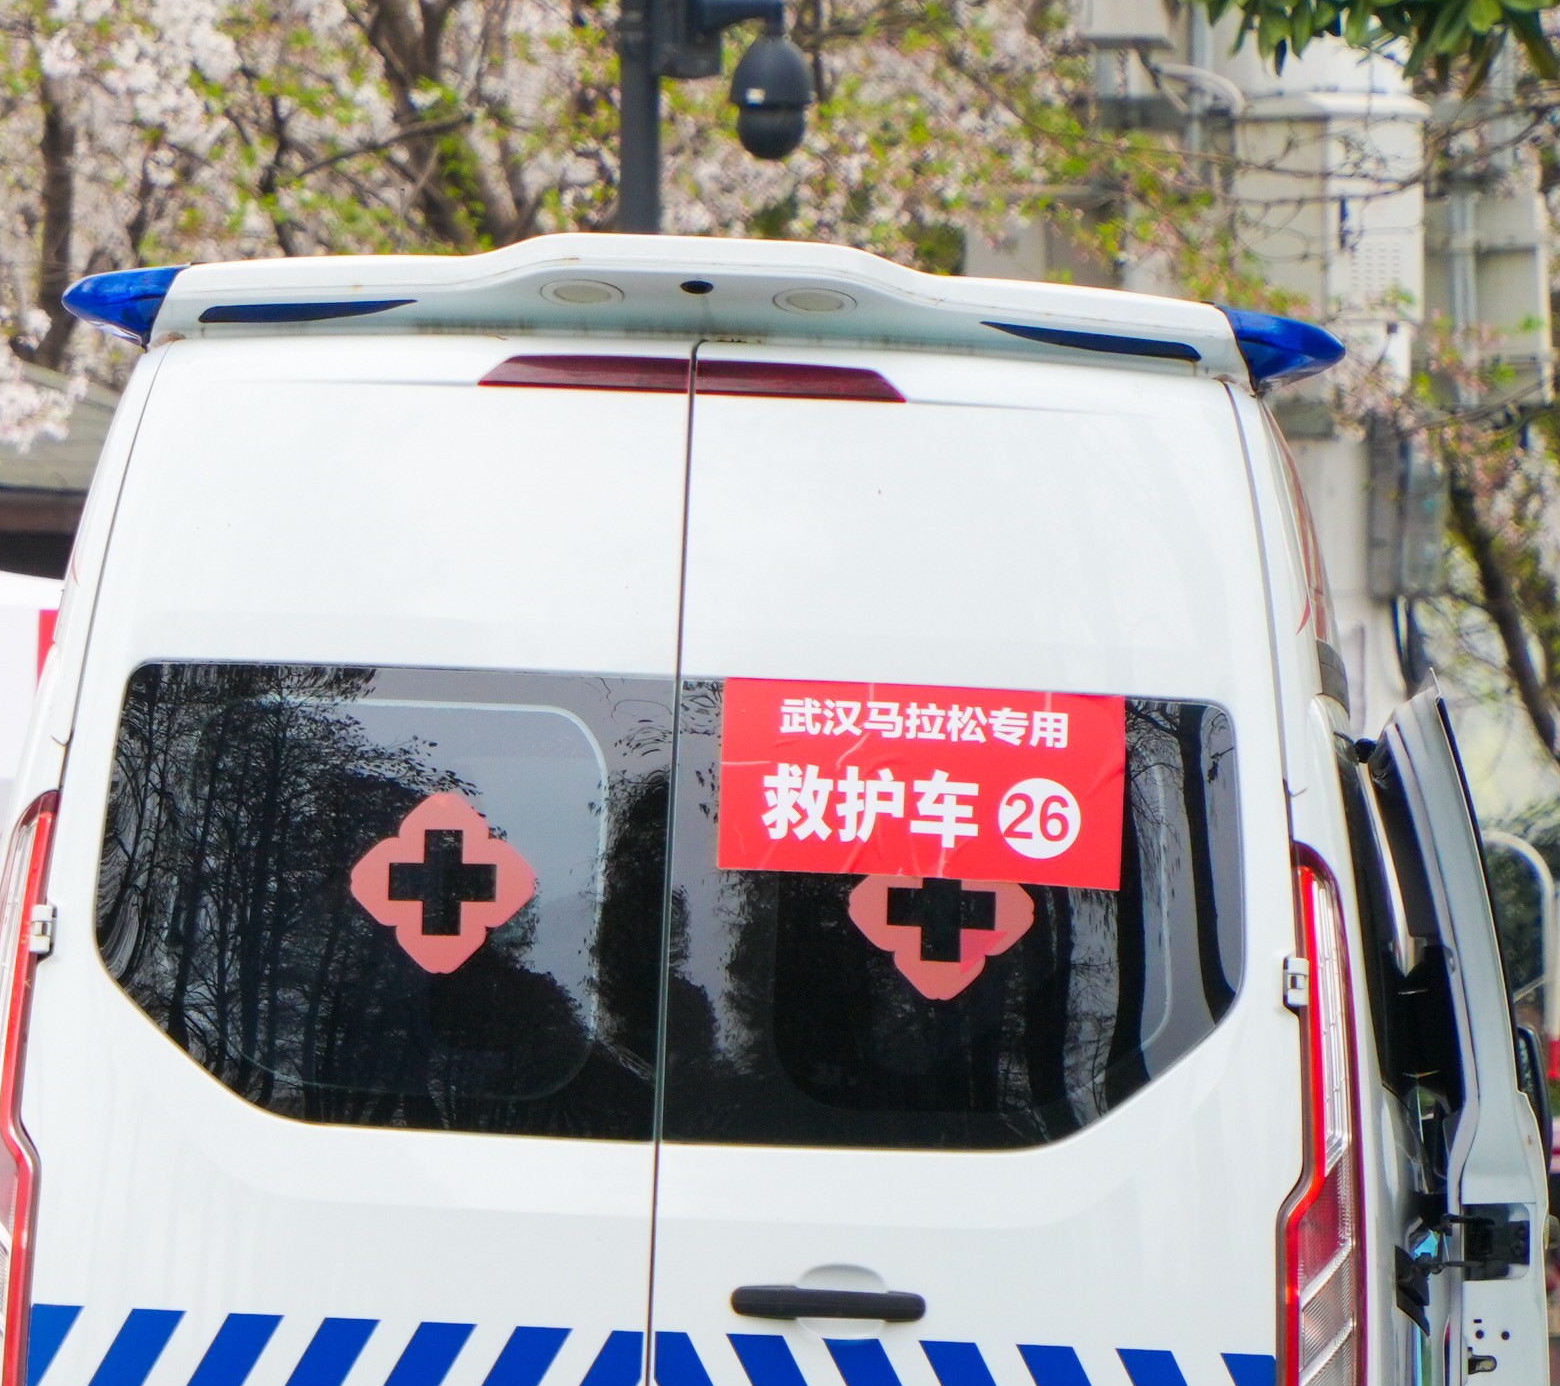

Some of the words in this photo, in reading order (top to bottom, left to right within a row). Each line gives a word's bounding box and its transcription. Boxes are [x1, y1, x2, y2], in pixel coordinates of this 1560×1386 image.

[779, 697, 1069, 749] 武汉马拉松专用
[761, 762, 980, 849] 救护车
[1002, 792, 1071, 843] 26
